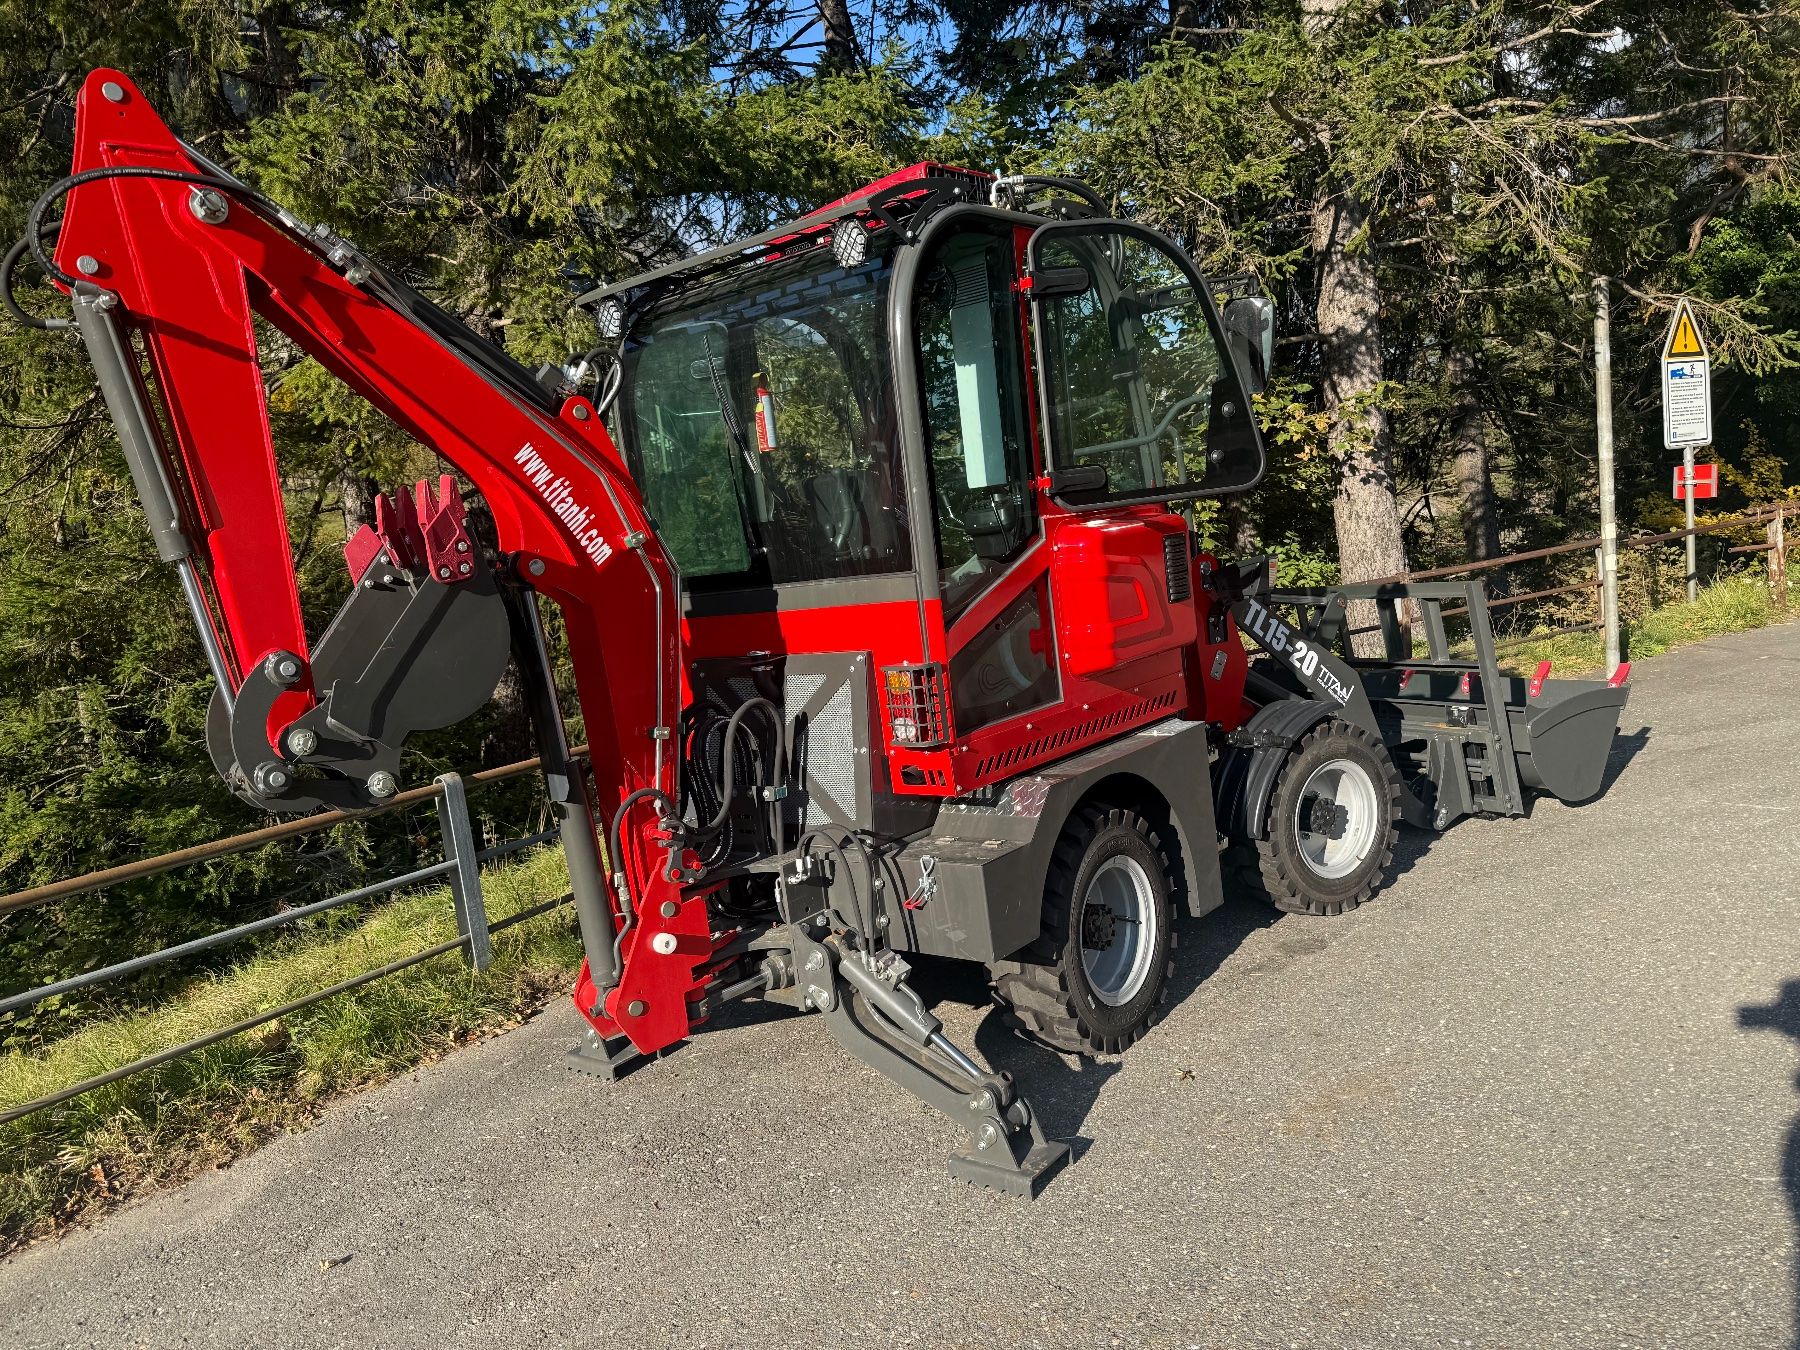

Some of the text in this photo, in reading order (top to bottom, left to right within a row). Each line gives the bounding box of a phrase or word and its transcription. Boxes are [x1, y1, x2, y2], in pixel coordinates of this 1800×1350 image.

[514, 442, 612, 566] www.titanhi.com
[1243, 599, 1319, 676] TL15-20
[1319, 664, 1355, 702] TITAN
